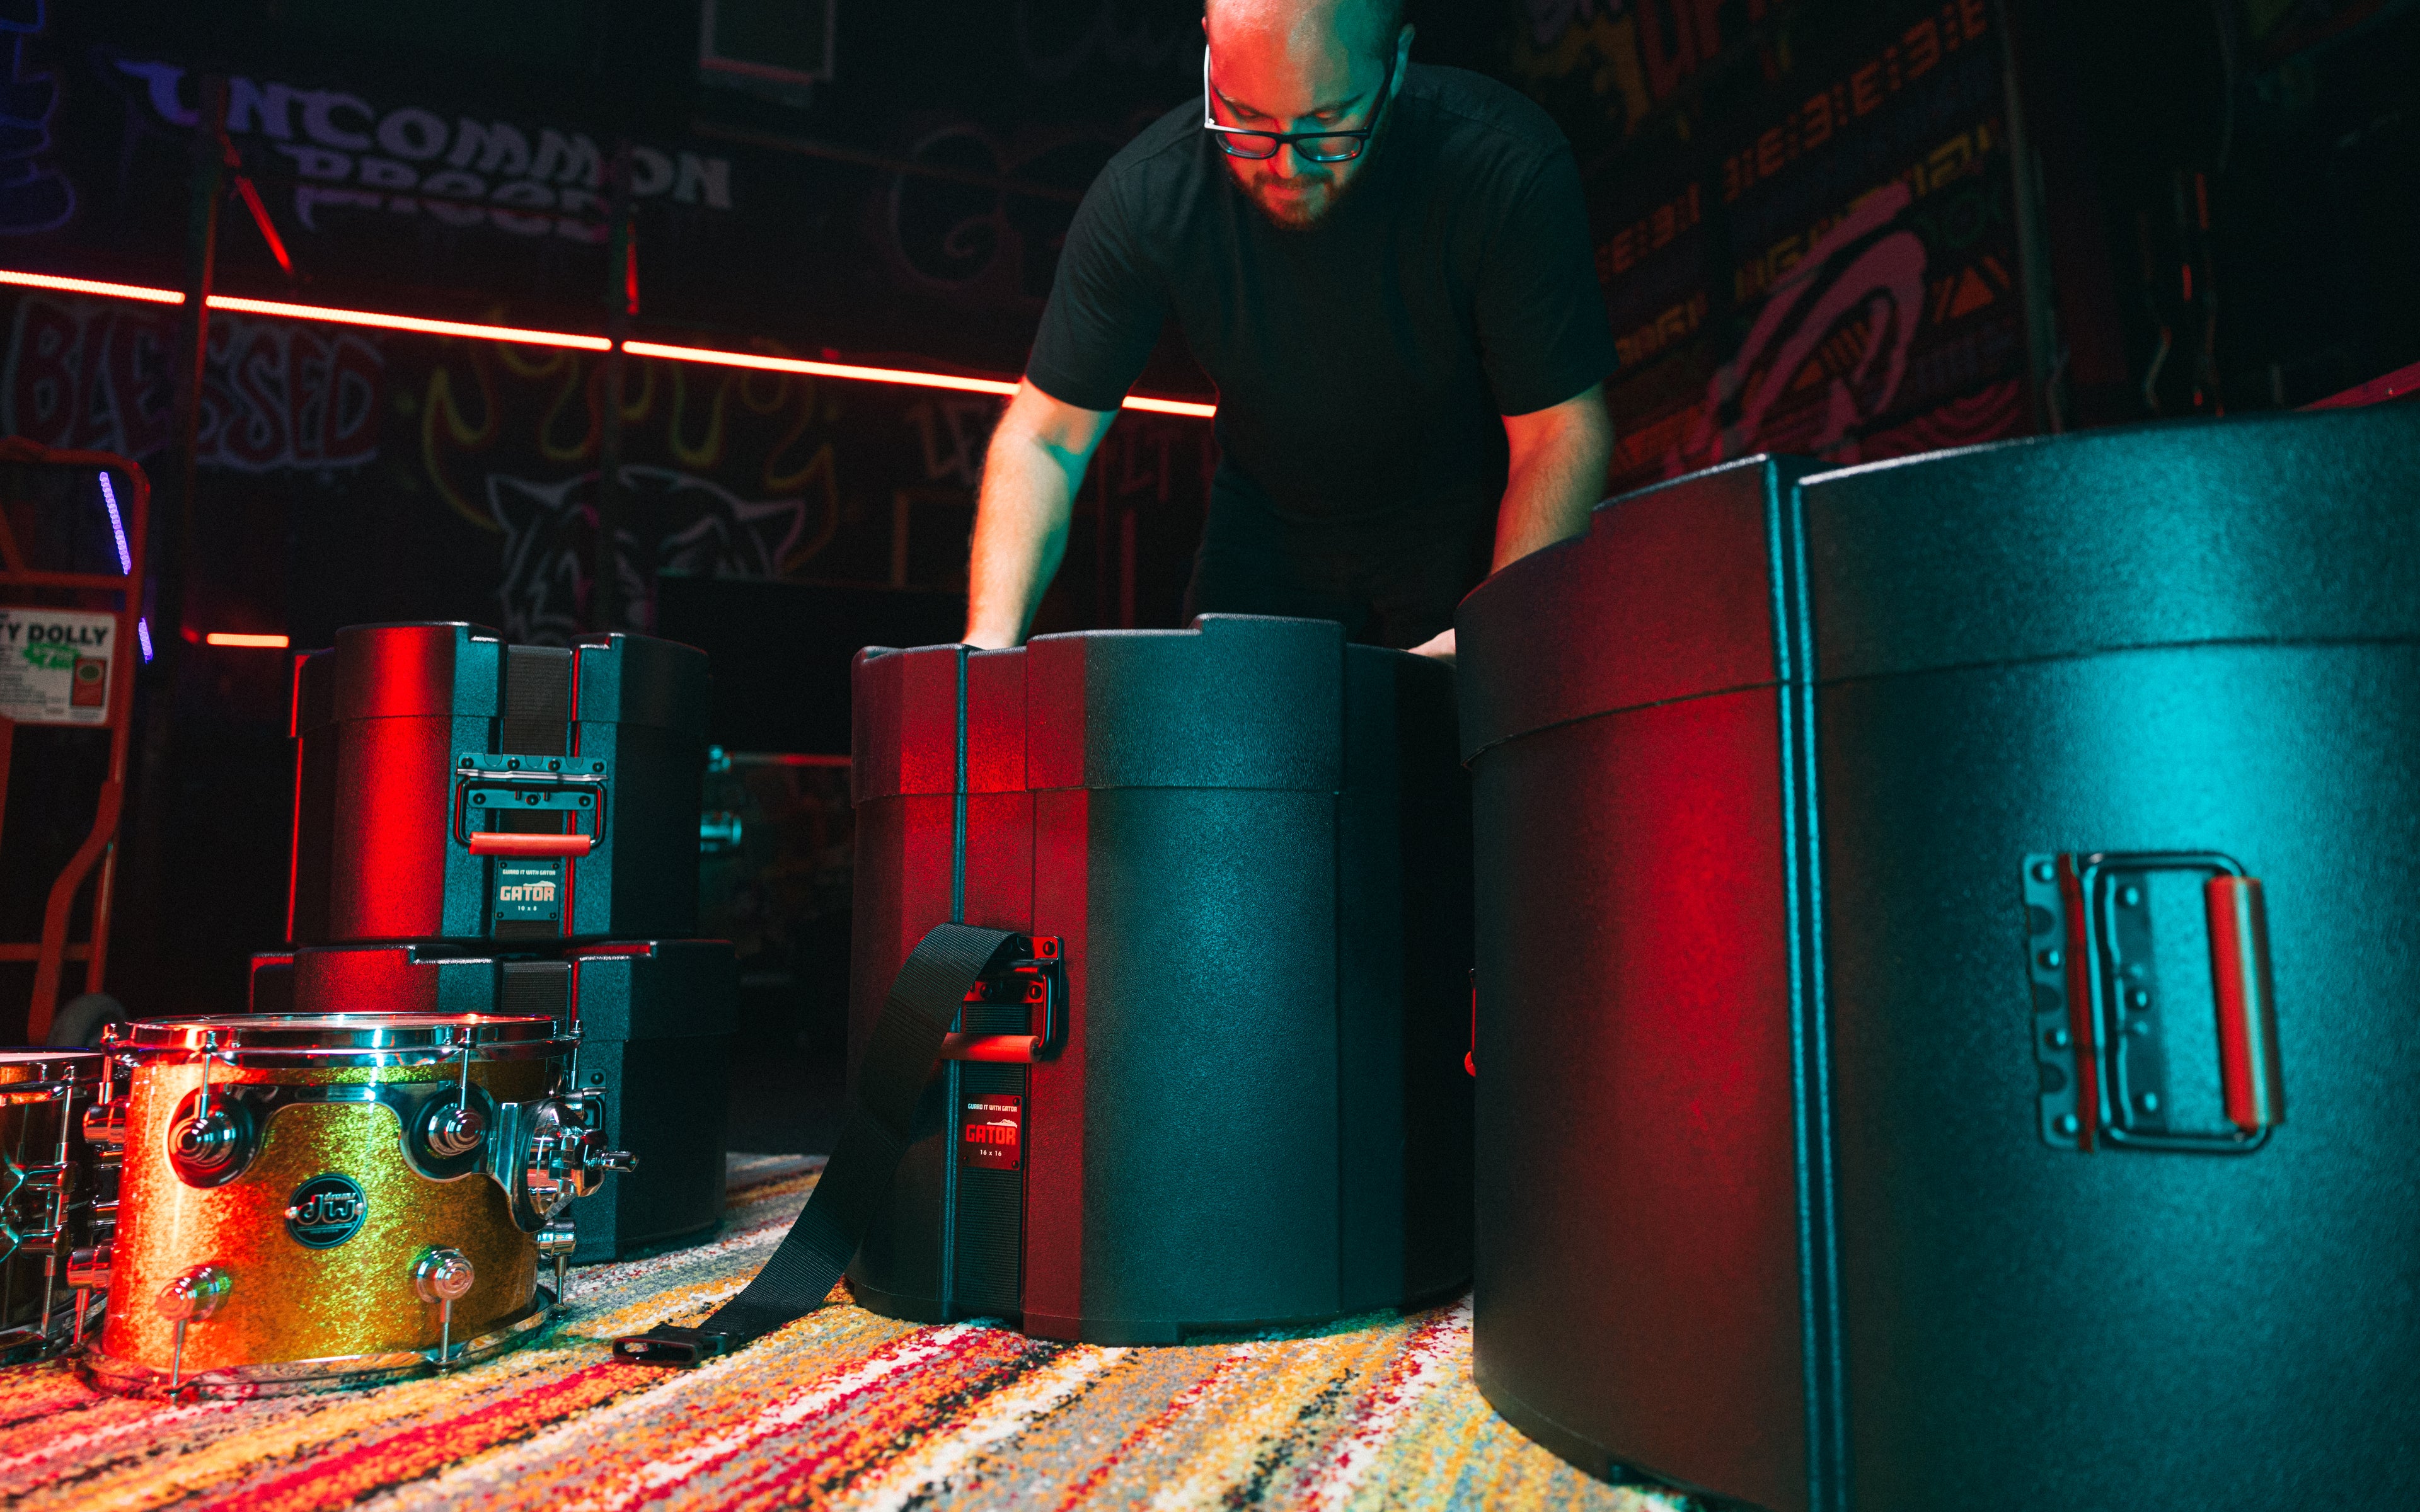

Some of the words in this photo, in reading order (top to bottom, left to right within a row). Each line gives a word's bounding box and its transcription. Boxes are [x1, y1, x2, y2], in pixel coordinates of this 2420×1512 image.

[28, 622, 107, 646] DOLLY
[500, 886, 555, 902] GATOR
[965, 1124, 1017, 1146] GATOR
